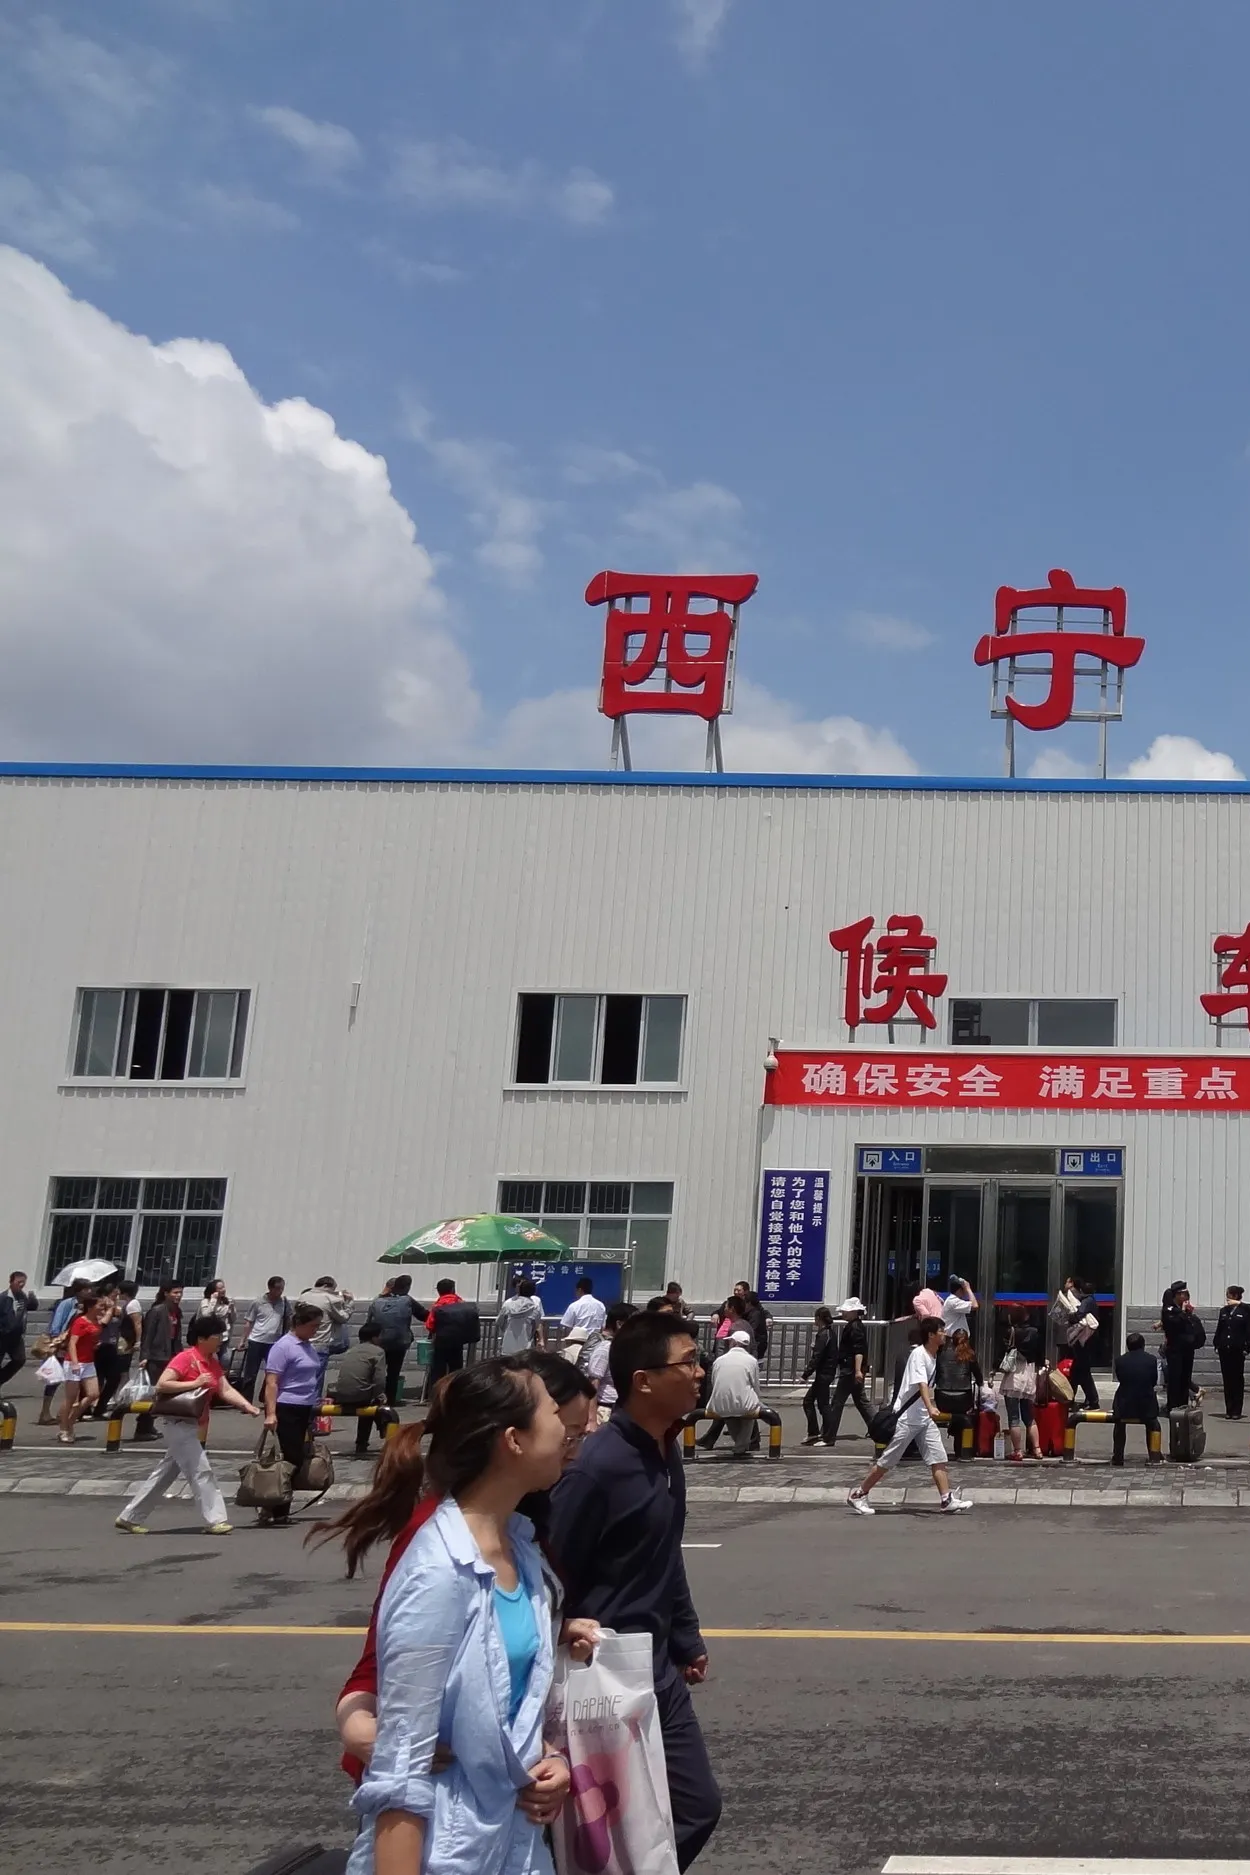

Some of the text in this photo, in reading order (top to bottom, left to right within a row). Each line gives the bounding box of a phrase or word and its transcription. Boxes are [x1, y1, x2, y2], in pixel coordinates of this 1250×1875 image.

[801, 1061, 1004, 1099] 确保安全
[1038, 1064, 1239, 1101] 满足重点
[889, 1151, 915, 1161] 入口
[1090, 1152, 1116, 1162] 出口
[812, 1177, 825, 1227] 温馨提示
[546, 1265, 584, 1275] 公告栏
[572, 1695, 623, 1722] DAPHNE
